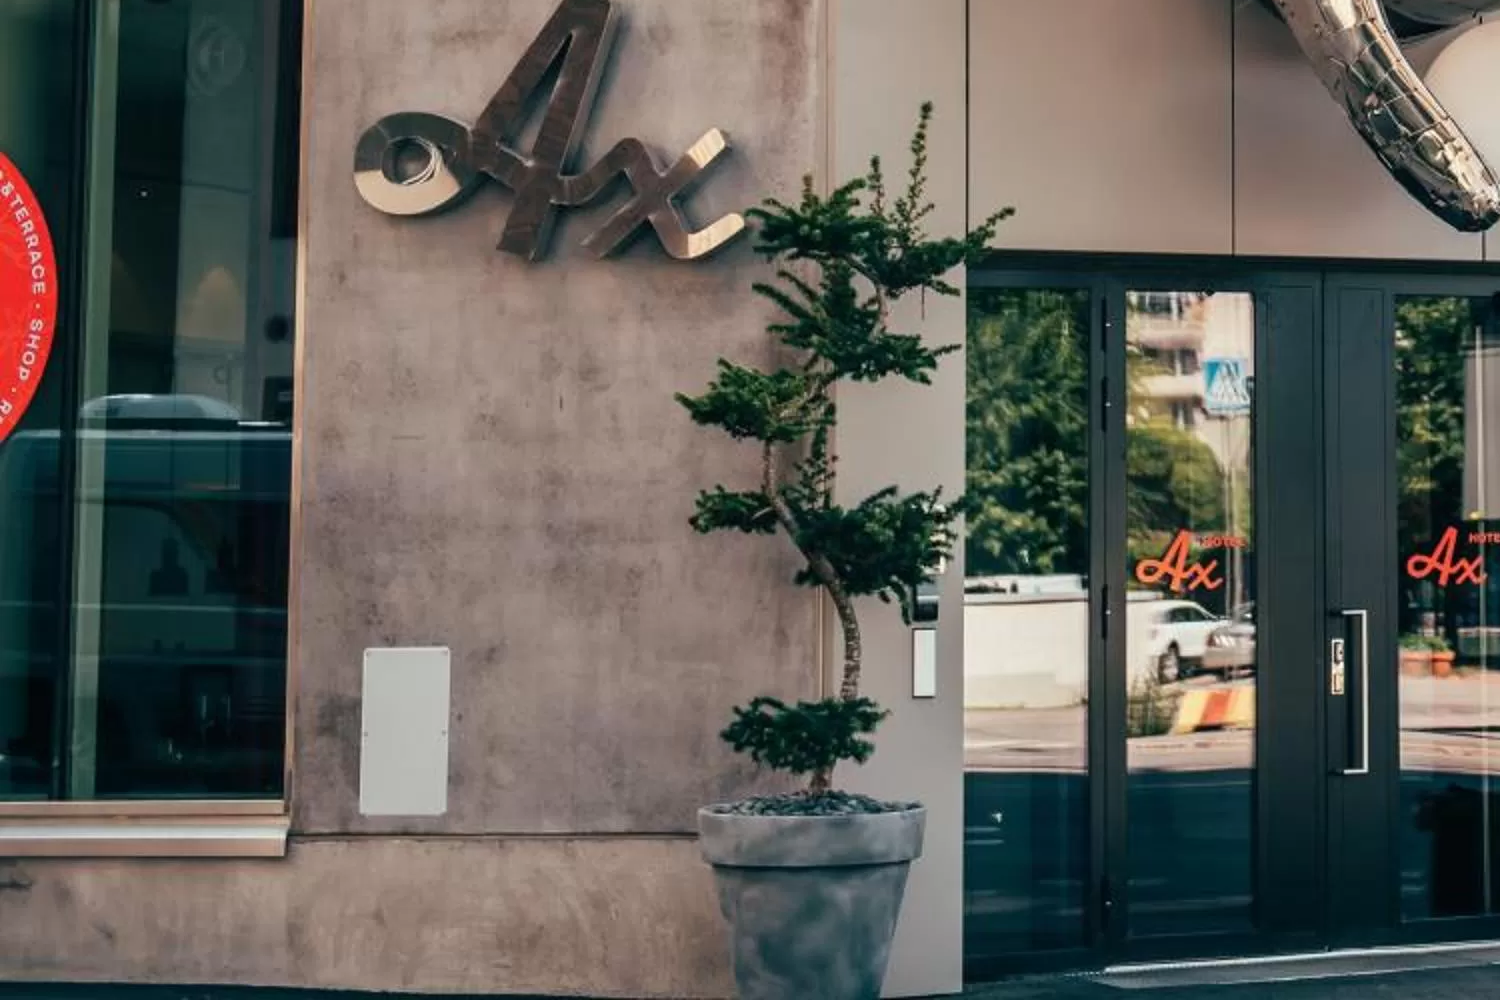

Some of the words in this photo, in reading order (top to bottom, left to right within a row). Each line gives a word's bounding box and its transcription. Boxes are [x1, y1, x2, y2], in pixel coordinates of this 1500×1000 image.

[19, 319, 43, 382] SHOP
[1135, 528, 1224, 593] Ax
[1406, 526, 1488, 587] Ax
